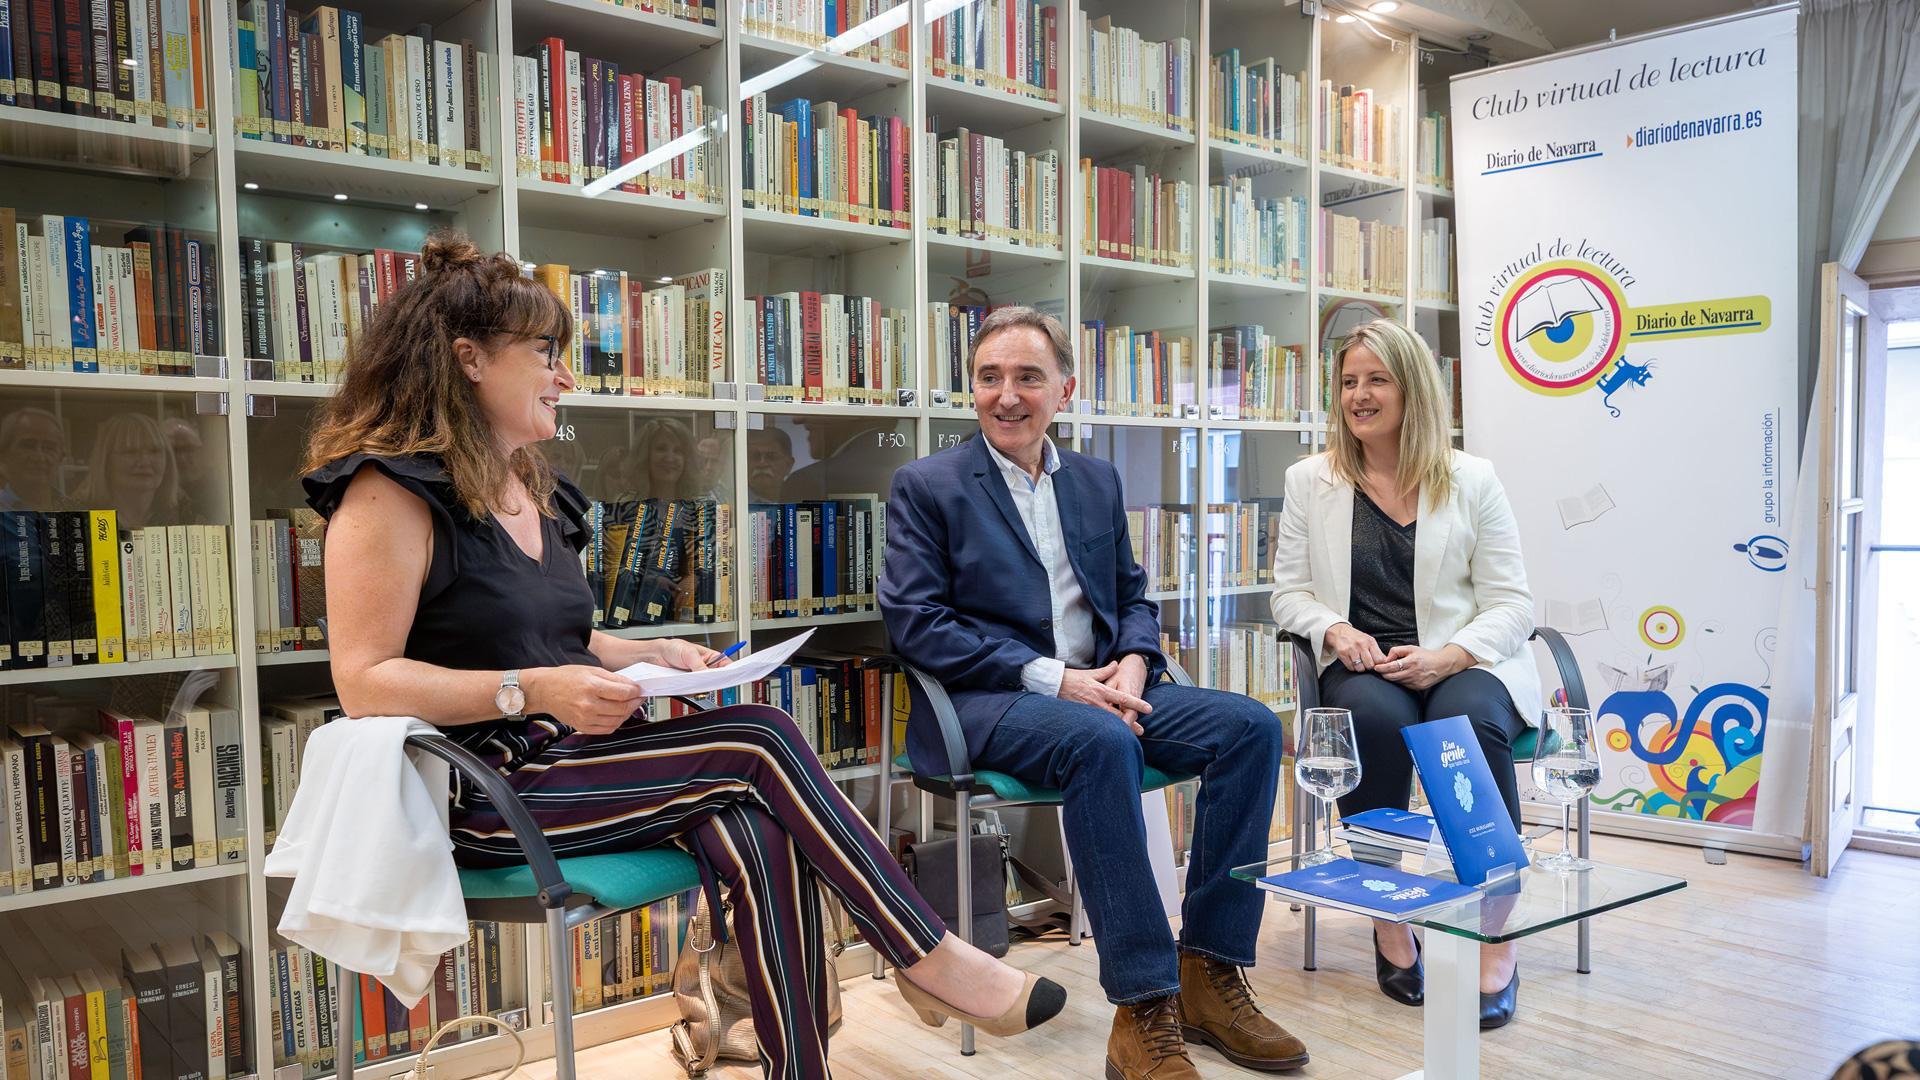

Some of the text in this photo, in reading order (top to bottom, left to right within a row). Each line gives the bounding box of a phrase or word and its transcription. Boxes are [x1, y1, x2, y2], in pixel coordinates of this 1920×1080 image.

[114, 1, 126, 47] PROTOCOLO
[350, 16, 360, 34] Garp
[289, 47, 303, 91] BERLÍN
[353, 58, 361, 82] mundo
[1472, 47, 1767, 121] Club virtual de lectura
[1635, 109, 1763, 148] diariodenavarra.es
[1486, 138, 1596, 170] Diario de Navarra
[1475, 237, 1636, 347] Club virtual de lectura
[710, 310, 724, 370] VATICANO
[1636, 305, 1754, 331] Diario de Navarra
[1761, 413, 1775, 524] grupo la información
[624, 547, 637, 571] JAMES
[633, 503, 646, 539] MICHENER
[656, 548, 668, 569] JAMES
[662, 502, 676, 538] MICHENER
[145, 733, 159, 798] ARTHUR HAILEY
[171, 732, 186, 789] Arthur Hailey
[215, 744, 241, 788] RACINES
[315, 956, 323, 976] MILLO
[293, 990, 306, 1048] CITA A CIEGAS
[318, 989, 328, 1024] KOSINSKI
[319, 1025, 330, 1047] JERZY
